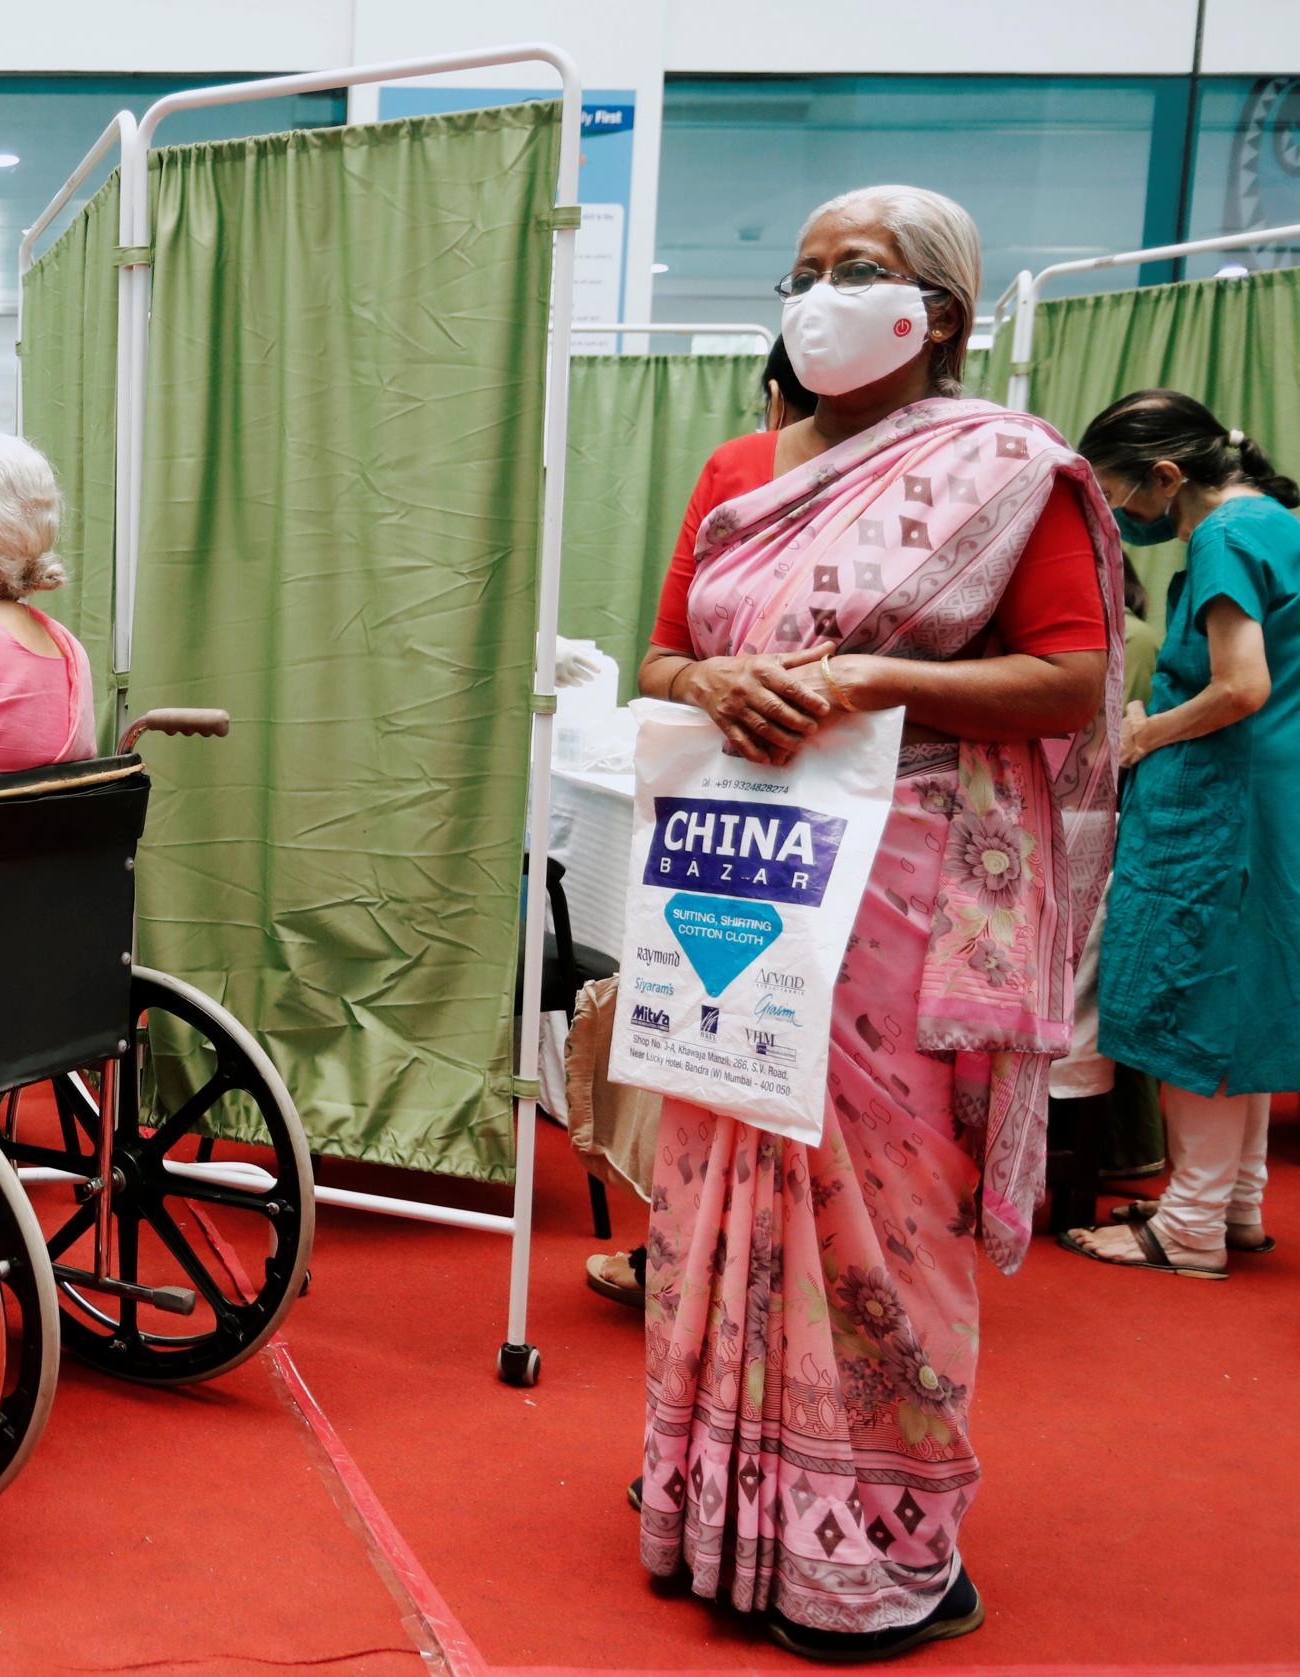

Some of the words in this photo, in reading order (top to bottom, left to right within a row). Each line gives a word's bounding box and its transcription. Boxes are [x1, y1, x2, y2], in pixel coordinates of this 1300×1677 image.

[595, 109, 622, 124] First
[663, 809, 816, 866] CHINA
[659, 857, 809, 890] BAZAR
[672, 908, 718, 925] SUITING,
[720, 915, 772, 932] SHIRTING
[678, 923, 723, 940] COTTON
[725, 930, 764, 946] CLOTH
[745, 1026, 776, 1047] VHM
[630, 1047, 645, 1060] Near
[646, 1052, 664, 1066] Lucky
[684, 1061, 709, 1076] Bandra
[710, 1067, 722, 1081] (W)
[723, 1070, 753, 1087] Mumbai
[760, 1080, 775, 1093] 400
[776, 1084, 791, 1096] 050
[633, 1034, 650, 1047] Shop
[651, 1039, 662, 1049] No.
[732, 1058, 749, 1071] 266,
[768, 1065, 788, 1081] Road,
